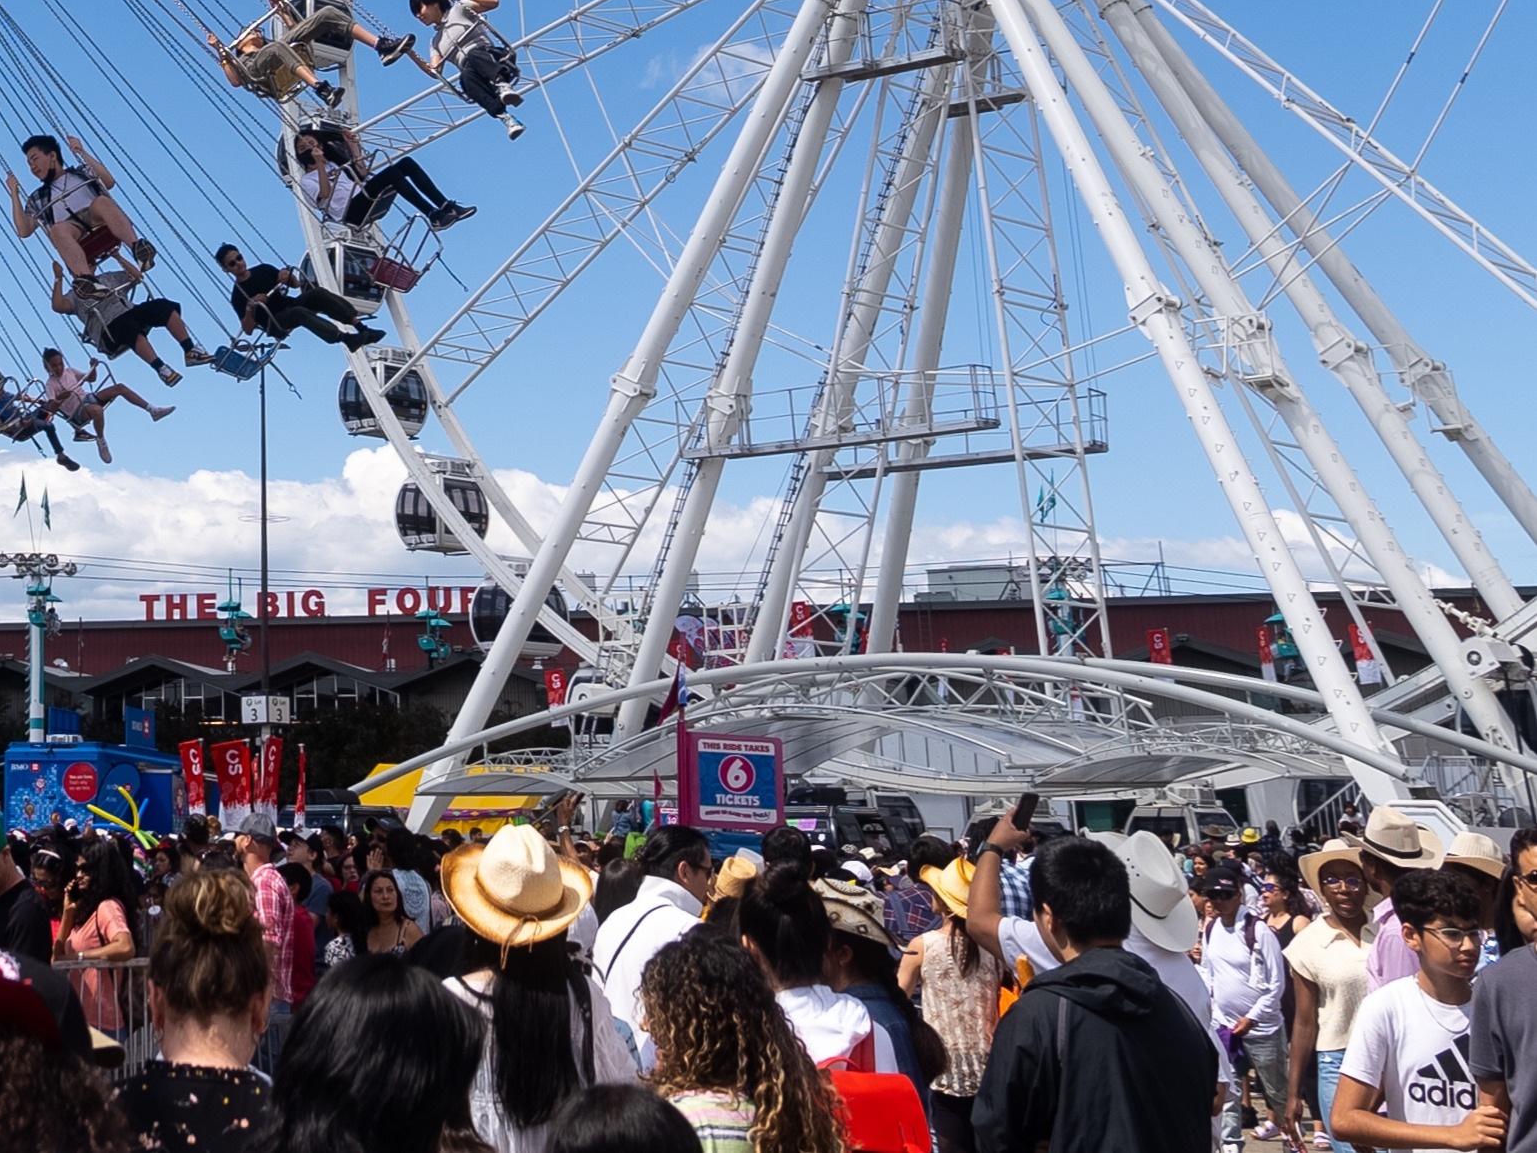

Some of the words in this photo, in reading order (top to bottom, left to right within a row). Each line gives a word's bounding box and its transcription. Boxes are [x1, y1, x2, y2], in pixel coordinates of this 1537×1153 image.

[139, 593, 217, 621] THE
[257, 589, 325, 619] BIG
[251, 708, 258, 722] 3
[276, 708, 283, 722] 3
[702, 741, 721, 751] THIS
[727, 758, 747, 789] 6
[715, 794, 760, 807] TICKETS
